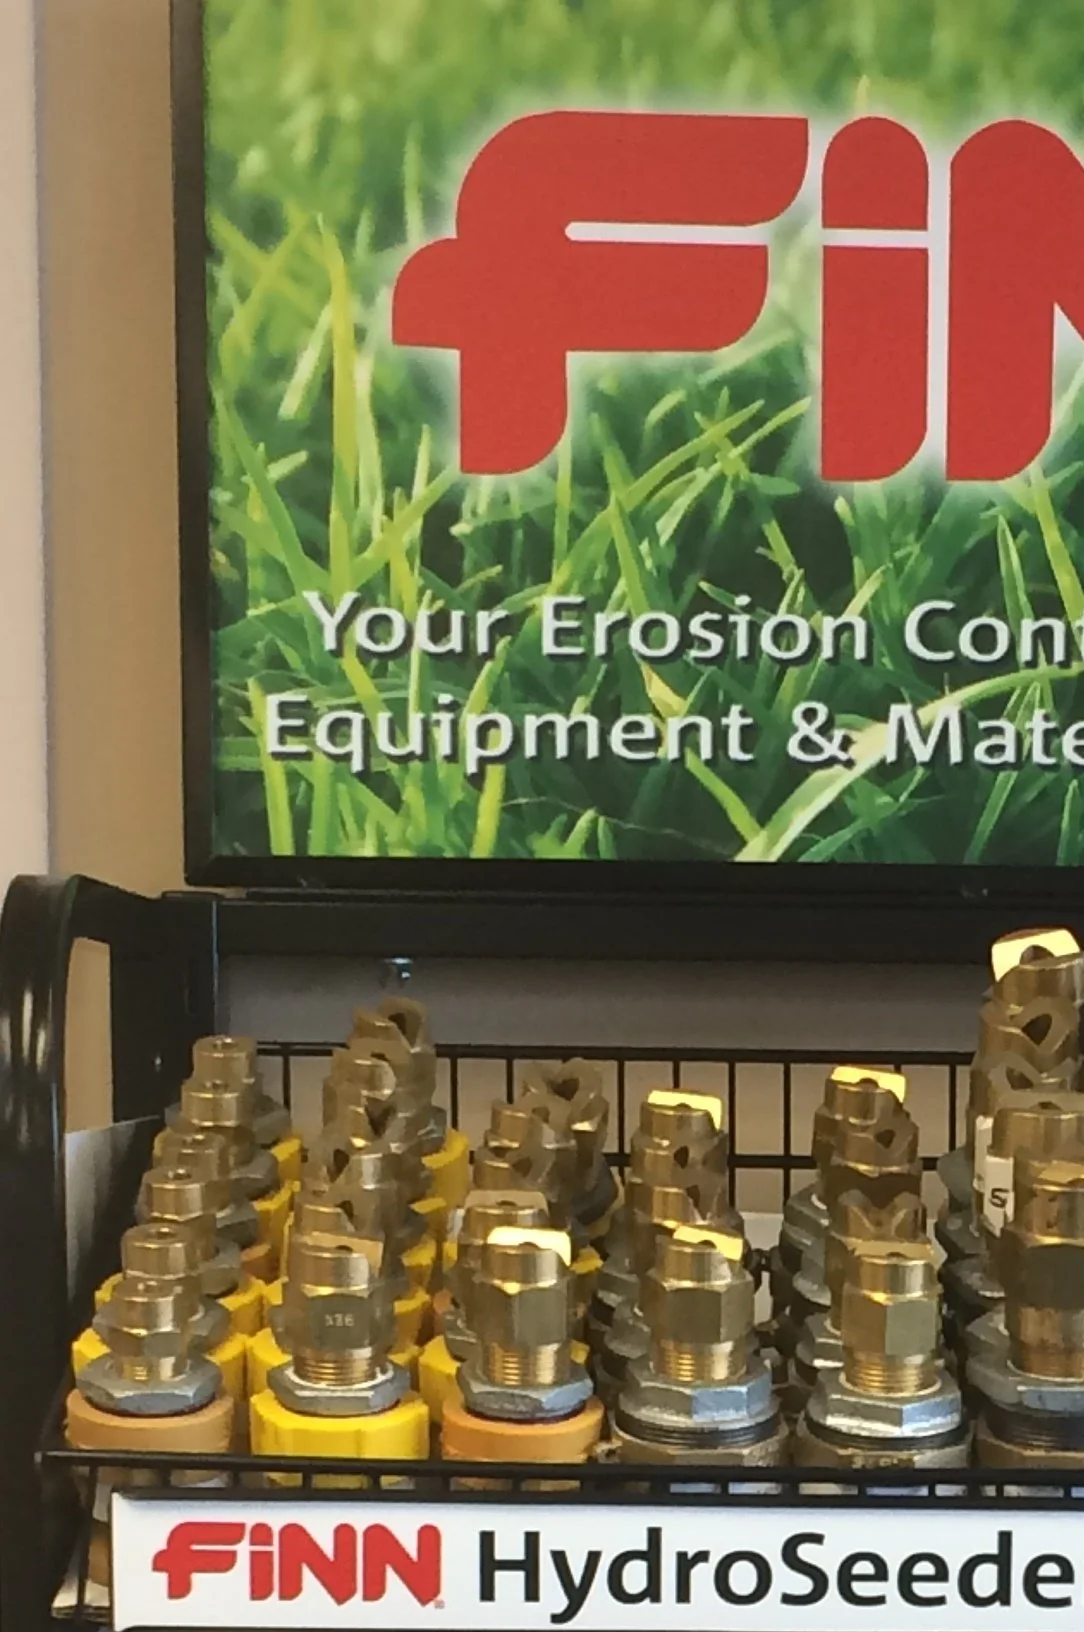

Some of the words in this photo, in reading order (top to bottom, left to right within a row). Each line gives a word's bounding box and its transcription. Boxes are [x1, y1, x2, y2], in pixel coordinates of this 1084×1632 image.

[303, 591, 507, 656] Your
[541, 595, 869, 661] Erosion
[265, 693, 755, 774] Equipment
[787, 701, 856, 762] &
